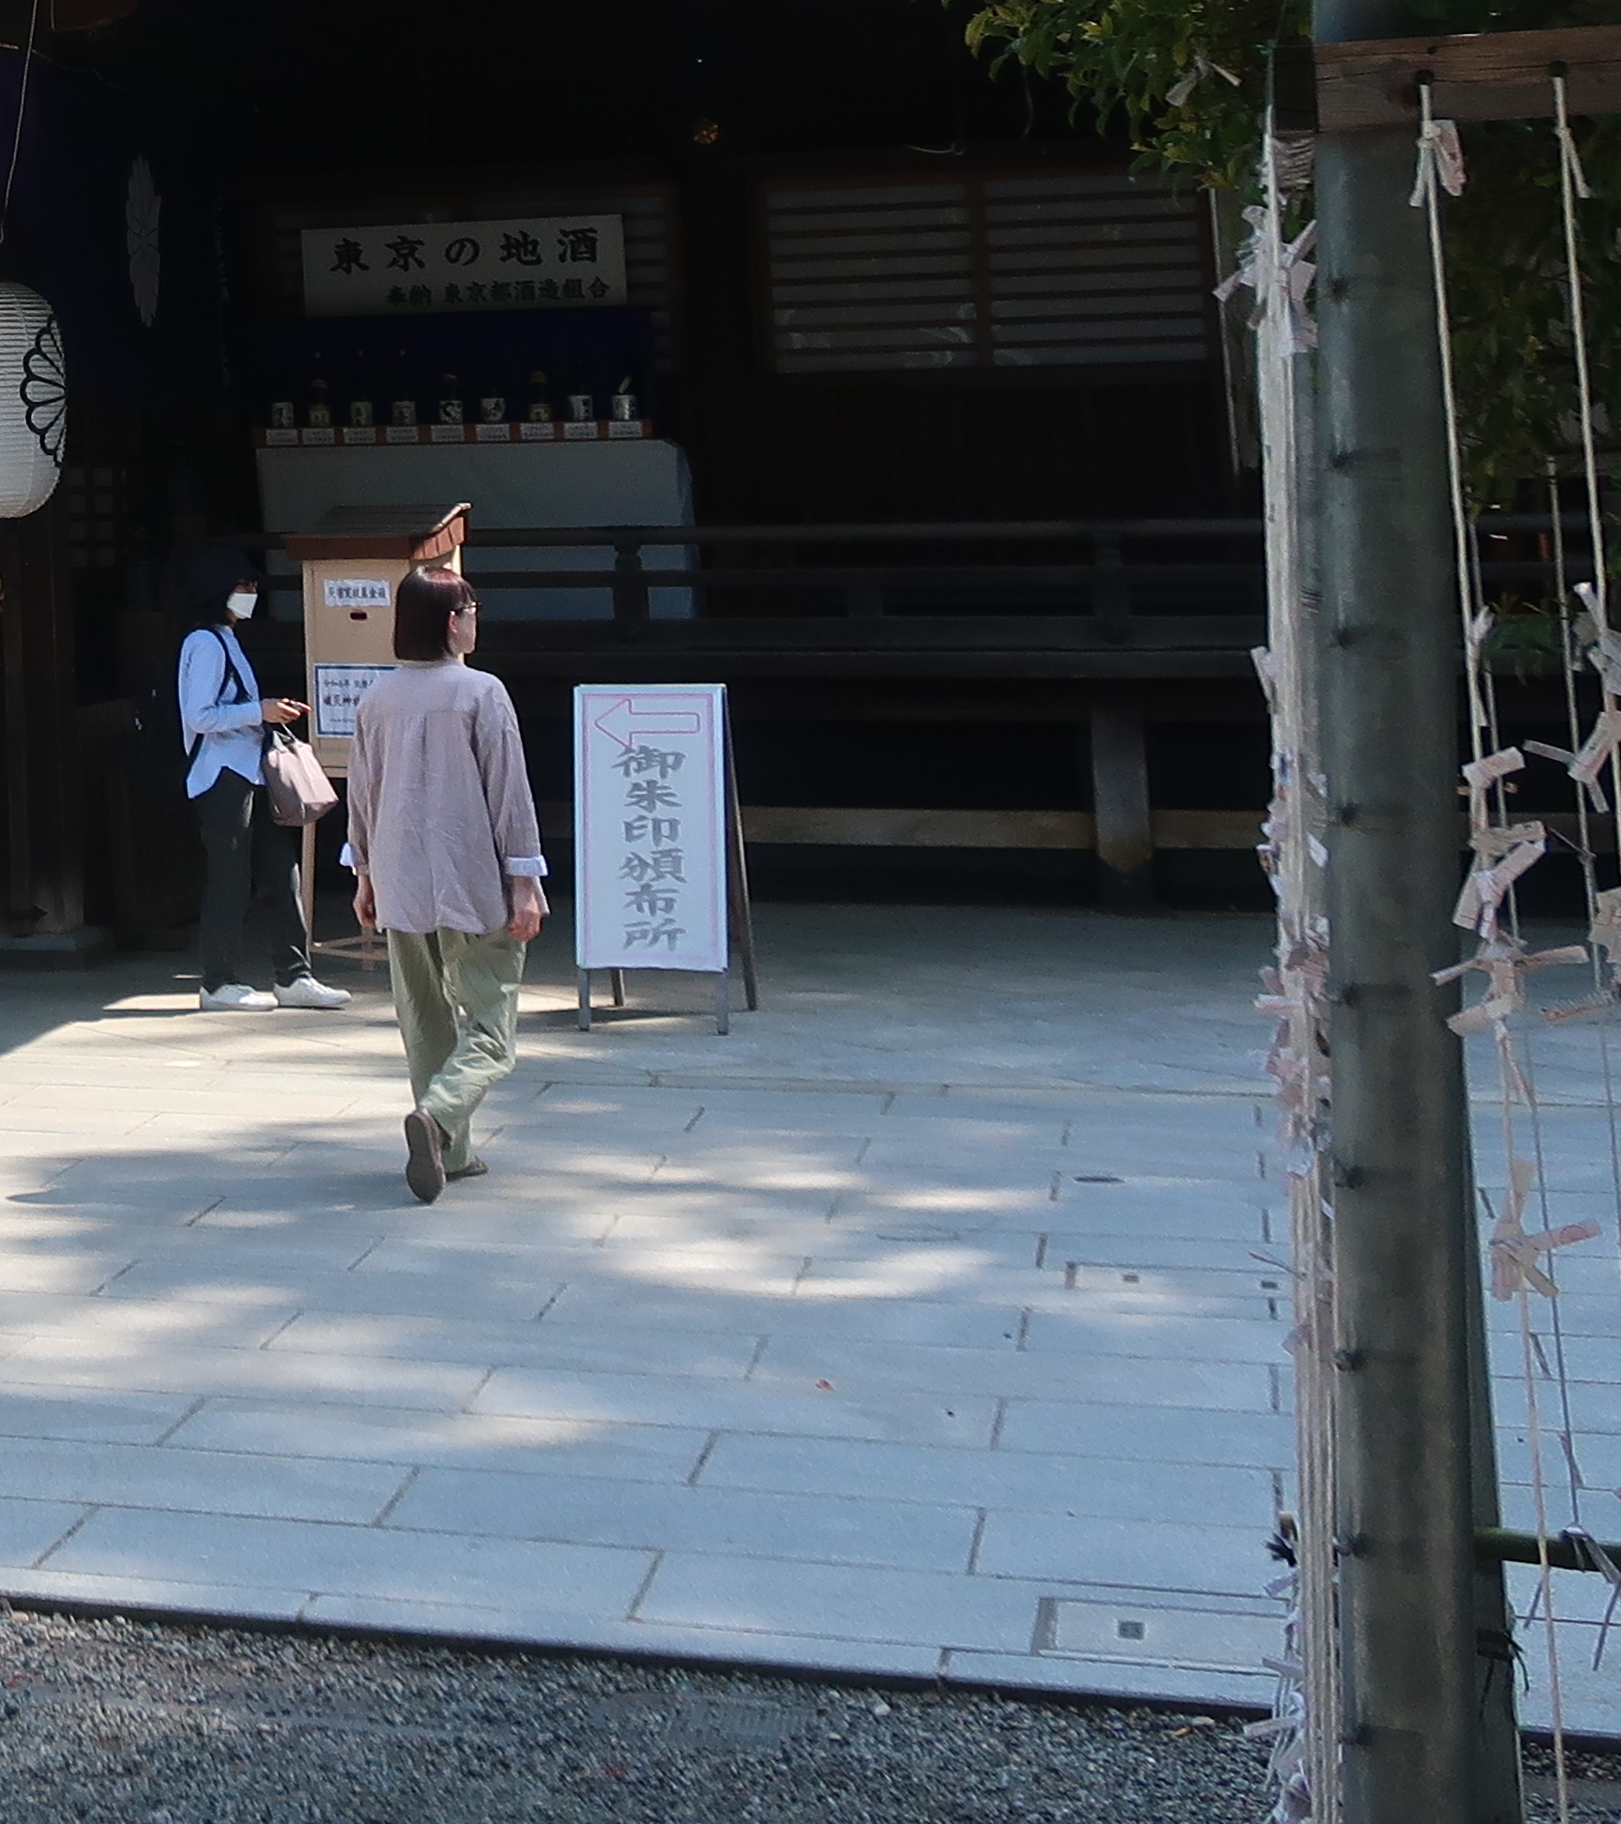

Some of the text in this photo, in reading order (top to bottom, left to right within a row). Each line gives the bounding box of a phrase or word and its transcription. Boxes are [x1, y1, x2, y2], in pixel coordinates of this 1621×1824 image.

[329, 227, 599, 275] 東京の地酒
[386, 276, 610, 307] 奉納 東京都酒造組合
[611, 744, 688, 952] 御朱印頒布所
